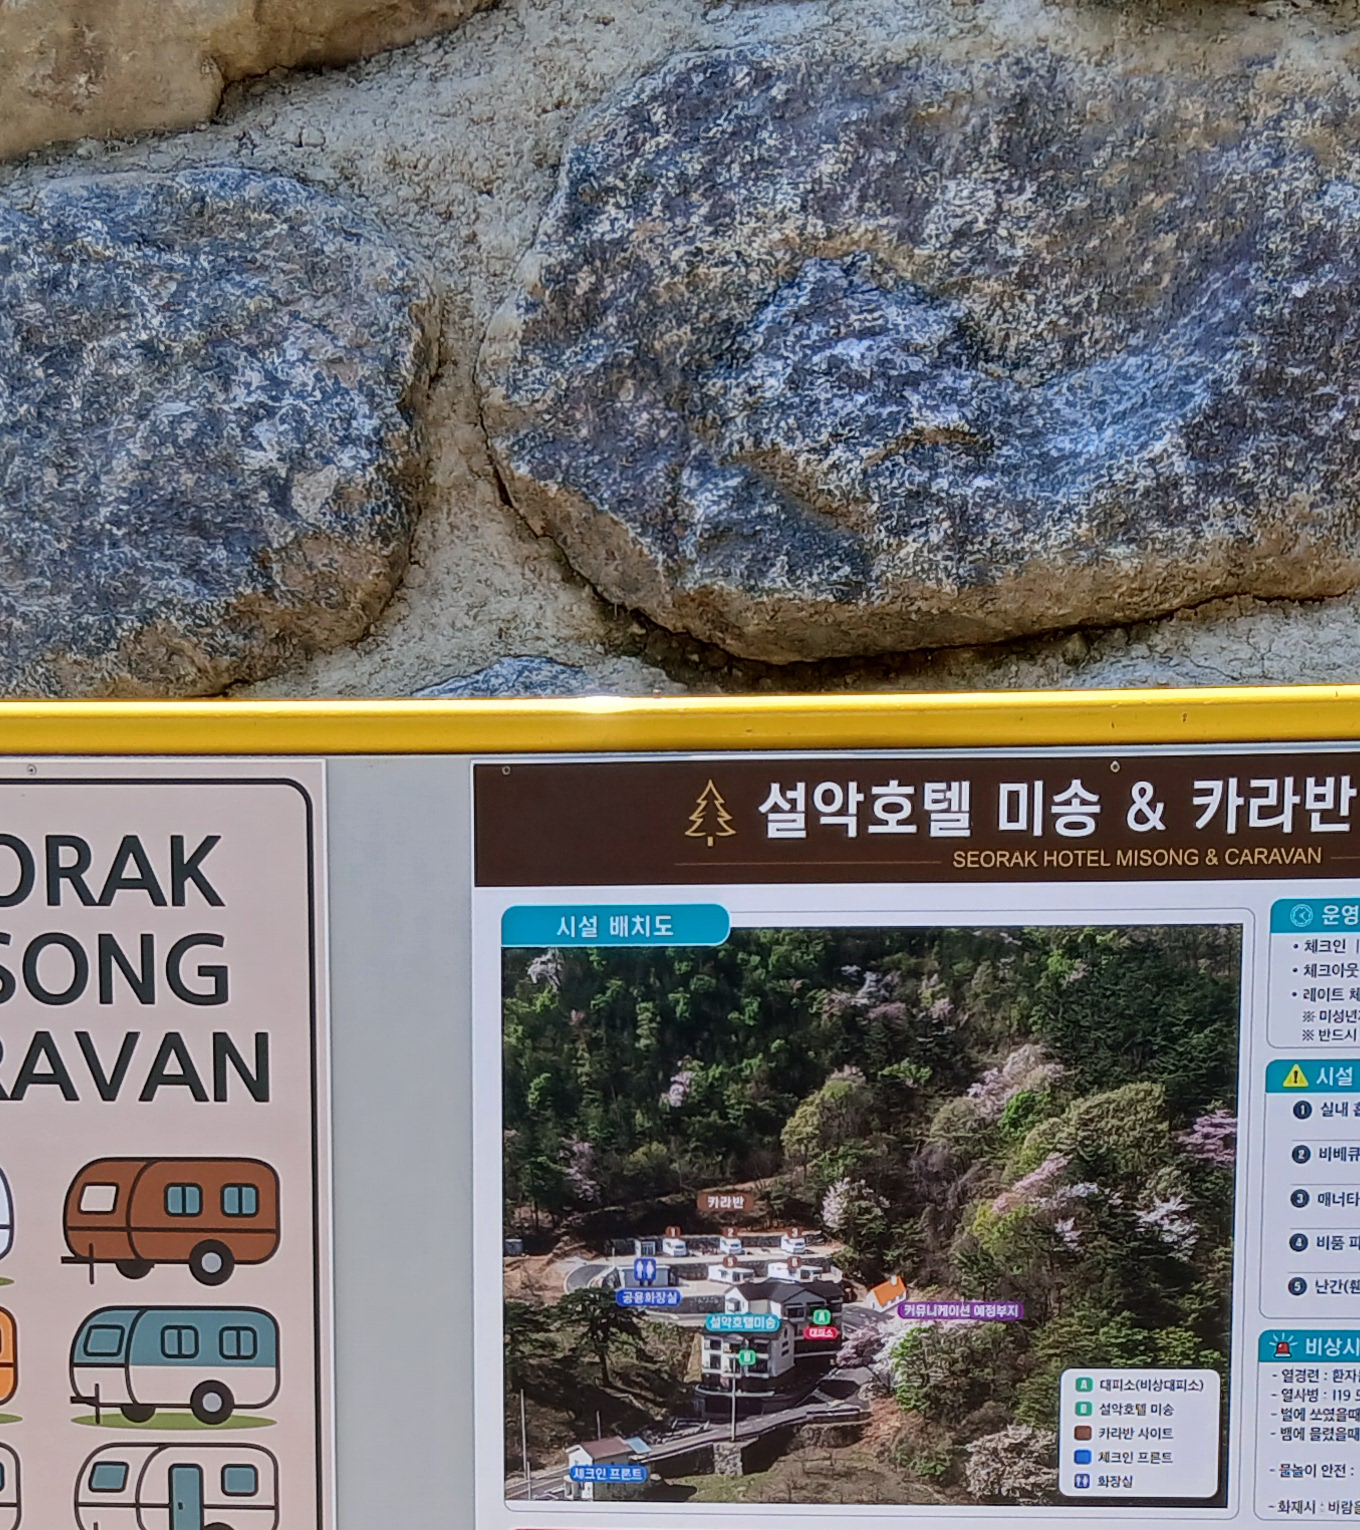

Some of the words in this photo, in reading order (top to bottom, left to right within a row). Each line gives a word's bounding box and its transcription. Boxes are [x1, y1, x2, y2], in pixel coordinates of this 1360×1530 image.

[758, 782, 971, 838] 설악호텔
[999, 780, 1101, 837] 미송
[1127, 782, 1166, 832] &
[1193, 777, 1357, 833] 카라반
[953, 851, 1039, 868] SEORAK
[1044, 850, 1111, 867] HOTEL
[1116, 849, 1199, 867] MISONG
[1206, 849, 1219, 866] &
[1225, 848, 1321, 865] CARAVAN
[556, 916, 597, 938] 시설
[610, 915, 674, 937] 배치도
[1304, 963, 1359, 978] 체크아웃
[1303, 987, 1345, 1003] 레이트
[1318, 1028, 1357, 1042] 반드시
[1316, 1067, 1353, 1086] 시설
[1321, 1102, 1349, 1118] 실내
[708, 1196, 744, 1209] 카라반
[1100, 1379, 1204, 1392] 대피소(비상대피소)
[1100, 1403, 1147, 1416] 설악호텔
[1150, 1403, 1175, 1417] 미송
[1099, 1427, 1135, 1440] 카라반
[1138, 1427, 1174, 1440] 사이트
[1098, 1475, 1133, 1489] 화장실
